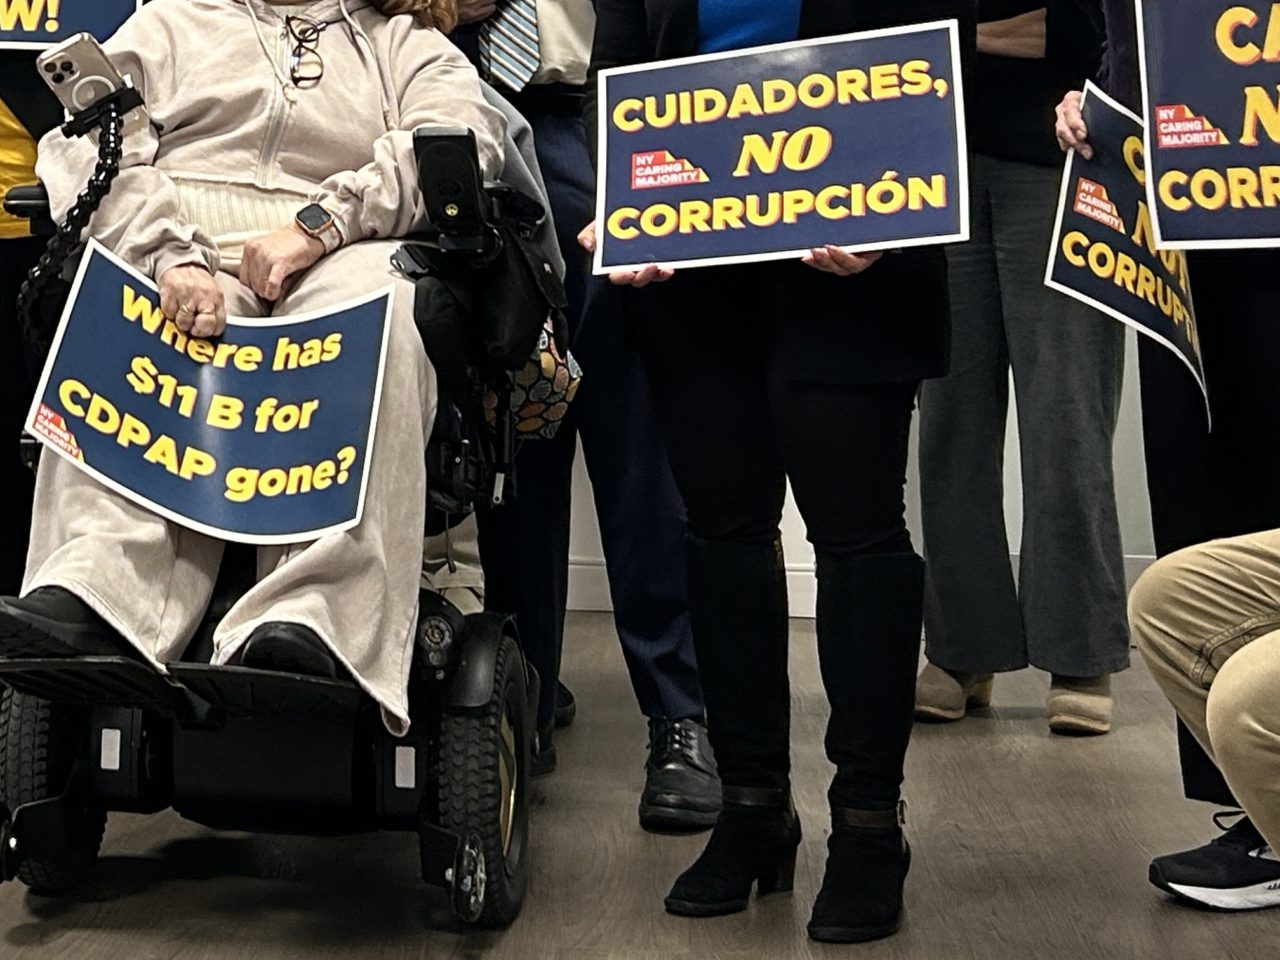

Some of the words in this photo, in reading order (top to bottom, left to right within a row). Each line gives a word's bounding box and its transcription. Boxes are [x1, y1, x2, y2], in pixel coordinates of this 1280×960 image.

[612, 60, 949, 133] CUIDADORES,
[1159, 109, 1176, 120] NY
[1160, 120, 1202, 134] CARING
[1161, 131, 1218, 146] MAJORITY
[636, 154, 656, 166] NY
[733, 126, 833, 178] NO
[635, 162, 683, 177] CARING
[635, 171, 699, 187] MAJORITY
[1081, 181, 1097, 194] NY
[607, 170, 947, 241] CORRUPCIÓN
[1078, 192, 1113, 213] CARING
[1076, 202, 1122, 229] MAJORITY
[272, 333, 342, 372] has
[126, 356, 198, 418] $11
[206, 394, 245, 430] B
[254, 397, 319, 433] for
[59, 379, 217, 481] CDPAP
[224, 446, 357, 503] gone?
